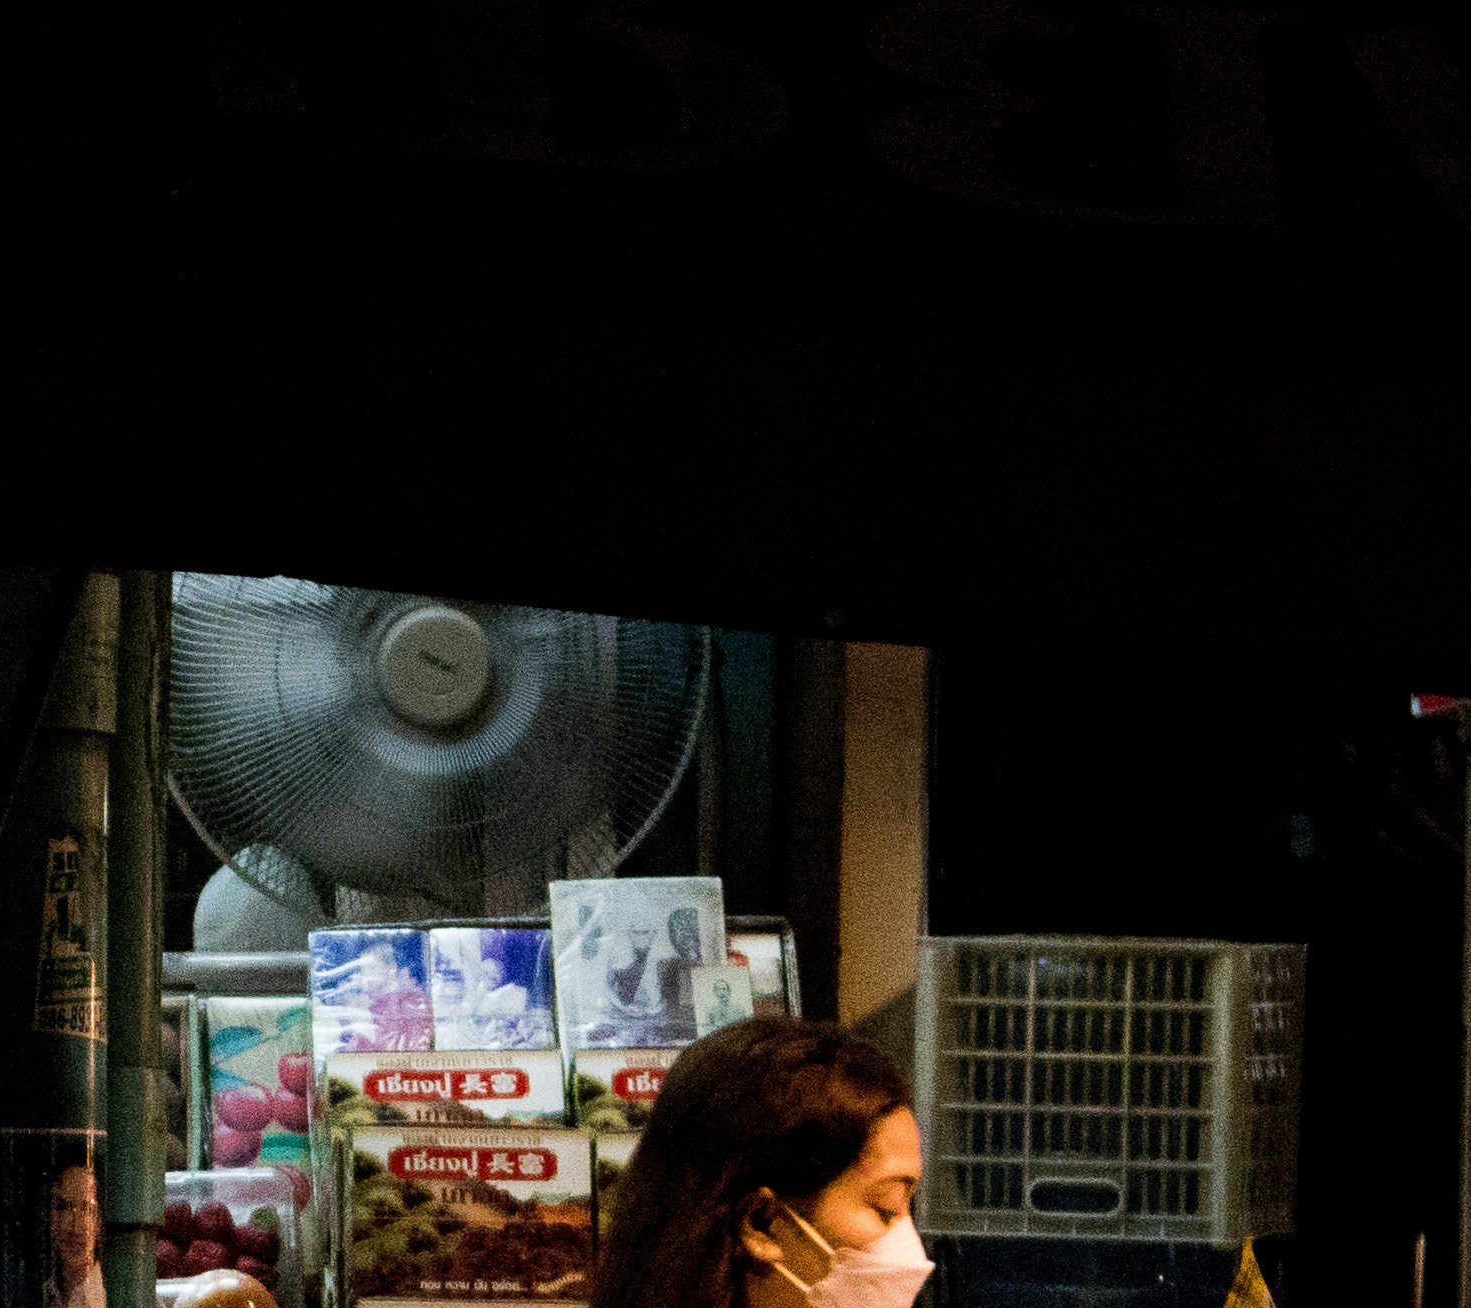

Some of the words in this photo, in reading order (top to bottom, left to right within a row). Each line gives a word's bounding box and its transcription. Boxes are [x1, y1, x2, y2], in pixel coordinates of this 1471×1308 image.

[377, 1072, 452, 1099] เชียงปู
[404, 1150, 479, 1177] เชียงปู
